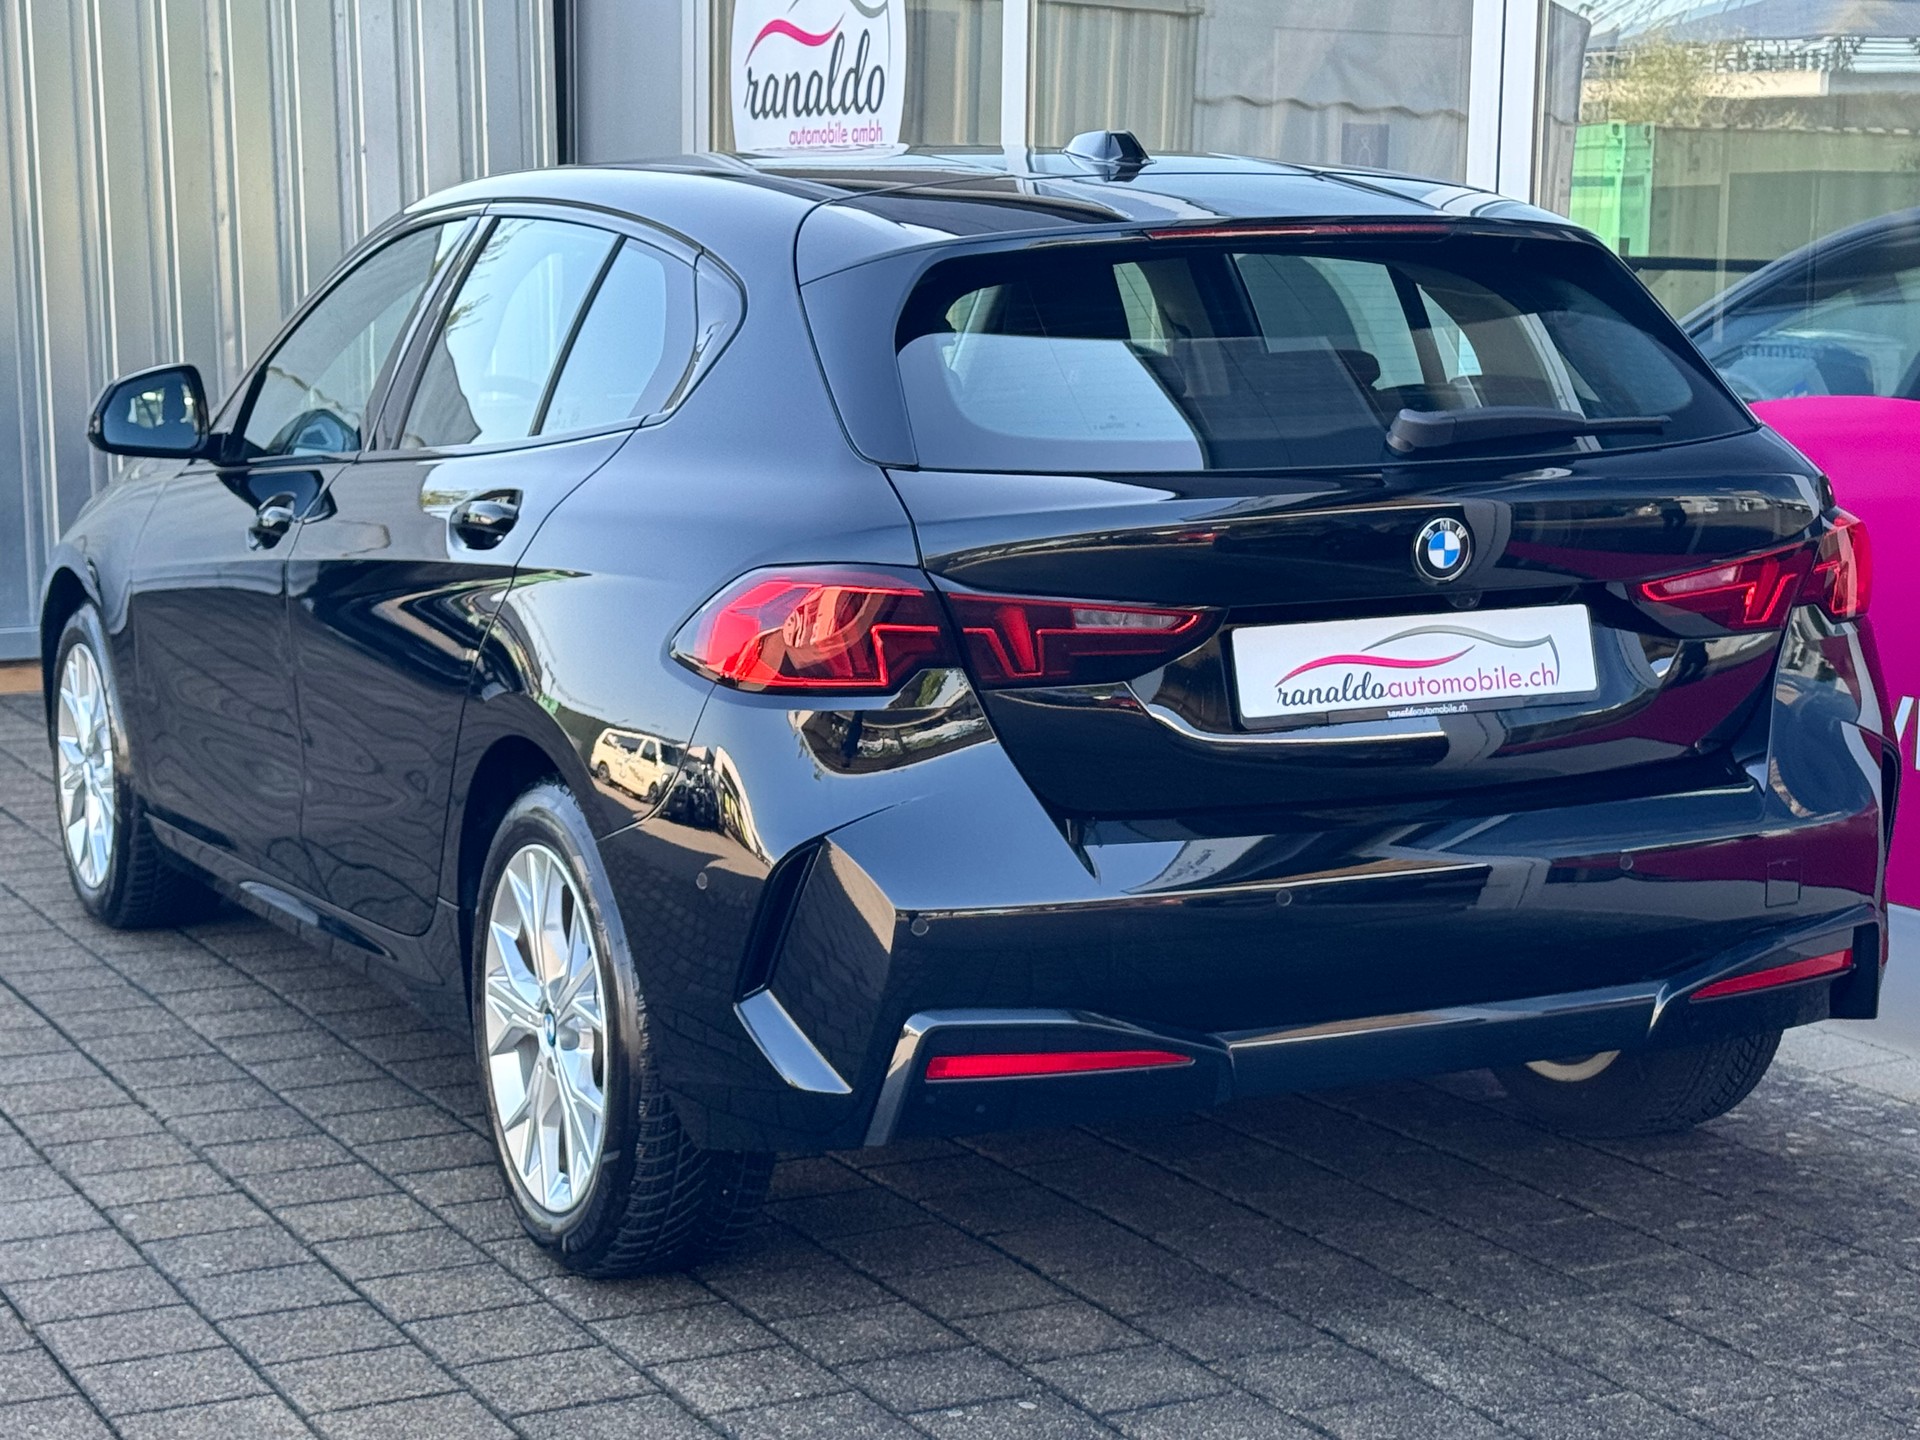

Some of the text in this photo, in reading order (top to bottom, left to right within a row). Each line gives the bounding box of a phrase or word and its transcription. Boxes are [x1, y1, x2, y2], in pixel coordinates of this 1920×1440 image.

[744, 28, 885, 120] ranaldo
[789, 121, 848, 145] automobile
[1423, 519, 1467, 540] BMW
